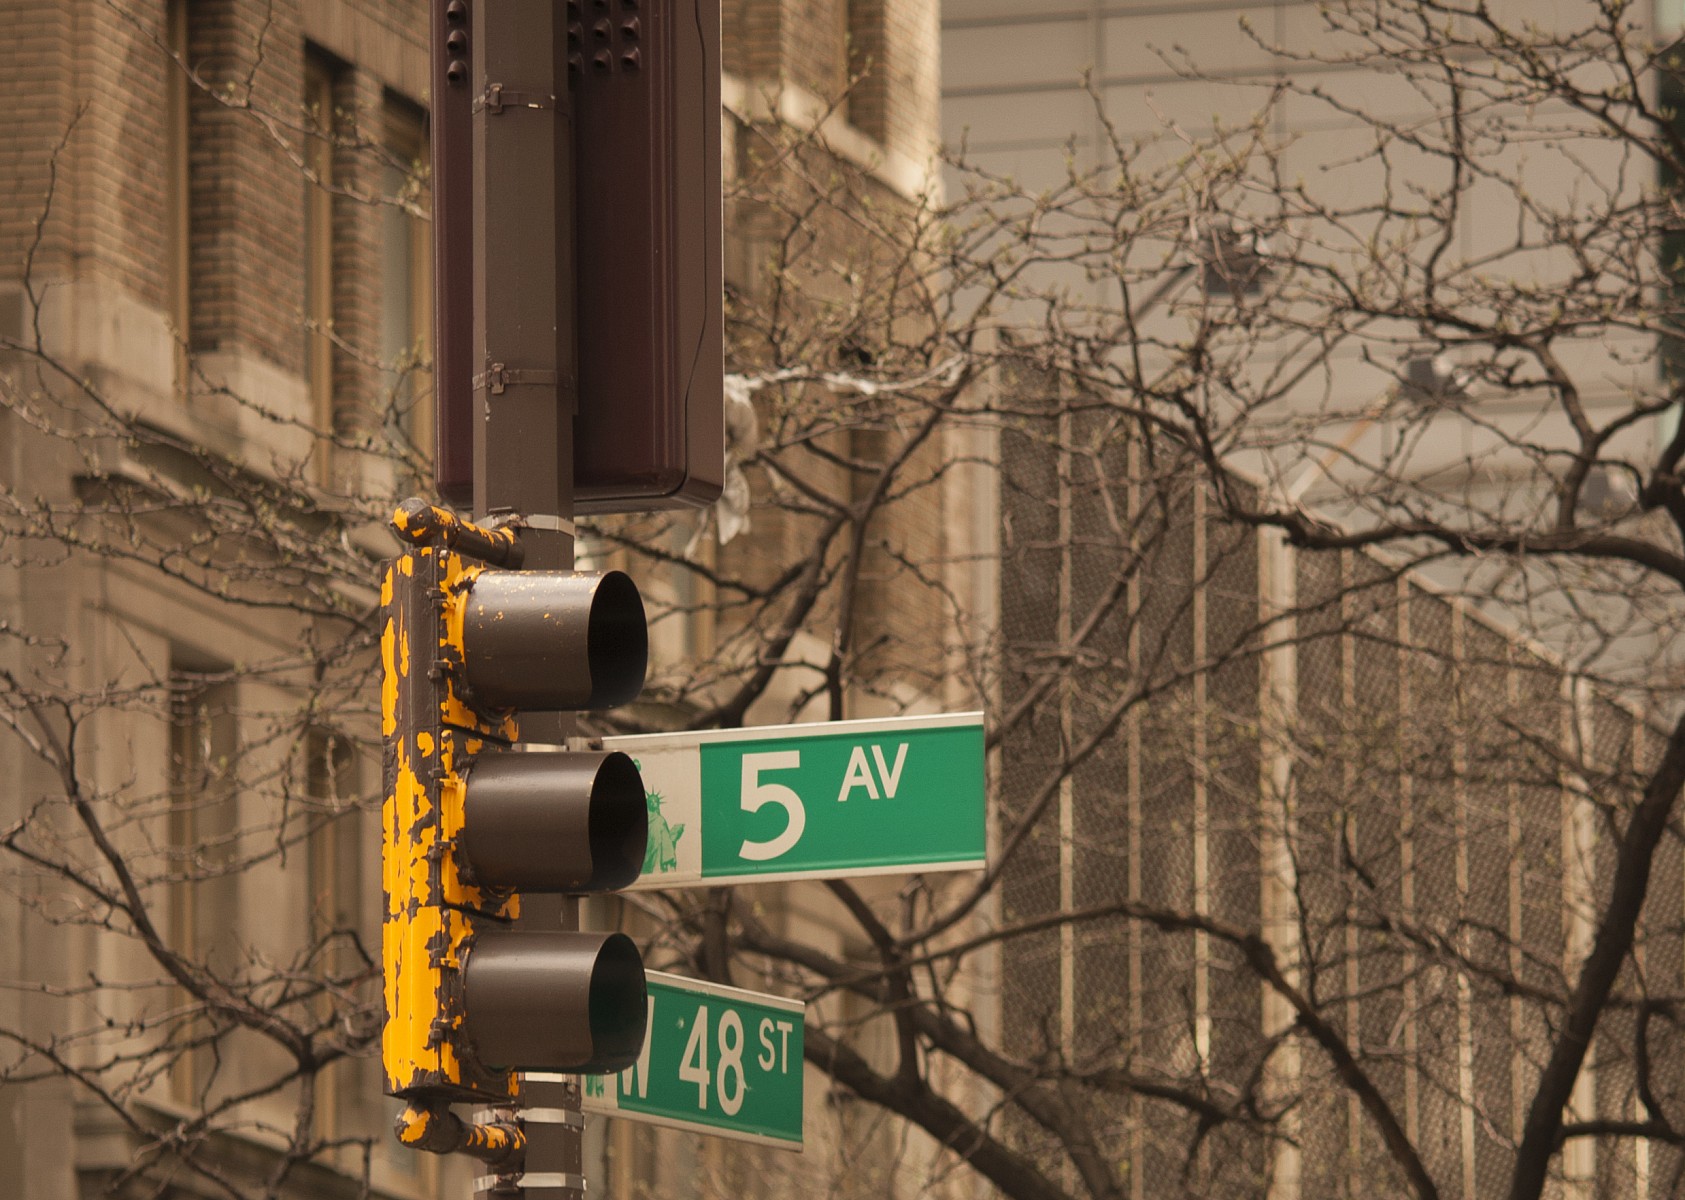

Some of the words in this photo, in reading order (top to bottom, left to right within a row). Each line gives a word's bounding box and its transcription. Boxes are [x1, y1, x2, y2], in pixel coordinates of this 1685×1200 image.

[738, 750, 806, 861] 5
[837, 743, 909, 802] AV
[679, 1005, 744, 1116] 48
[758, 1017, 793, 1074] ST
